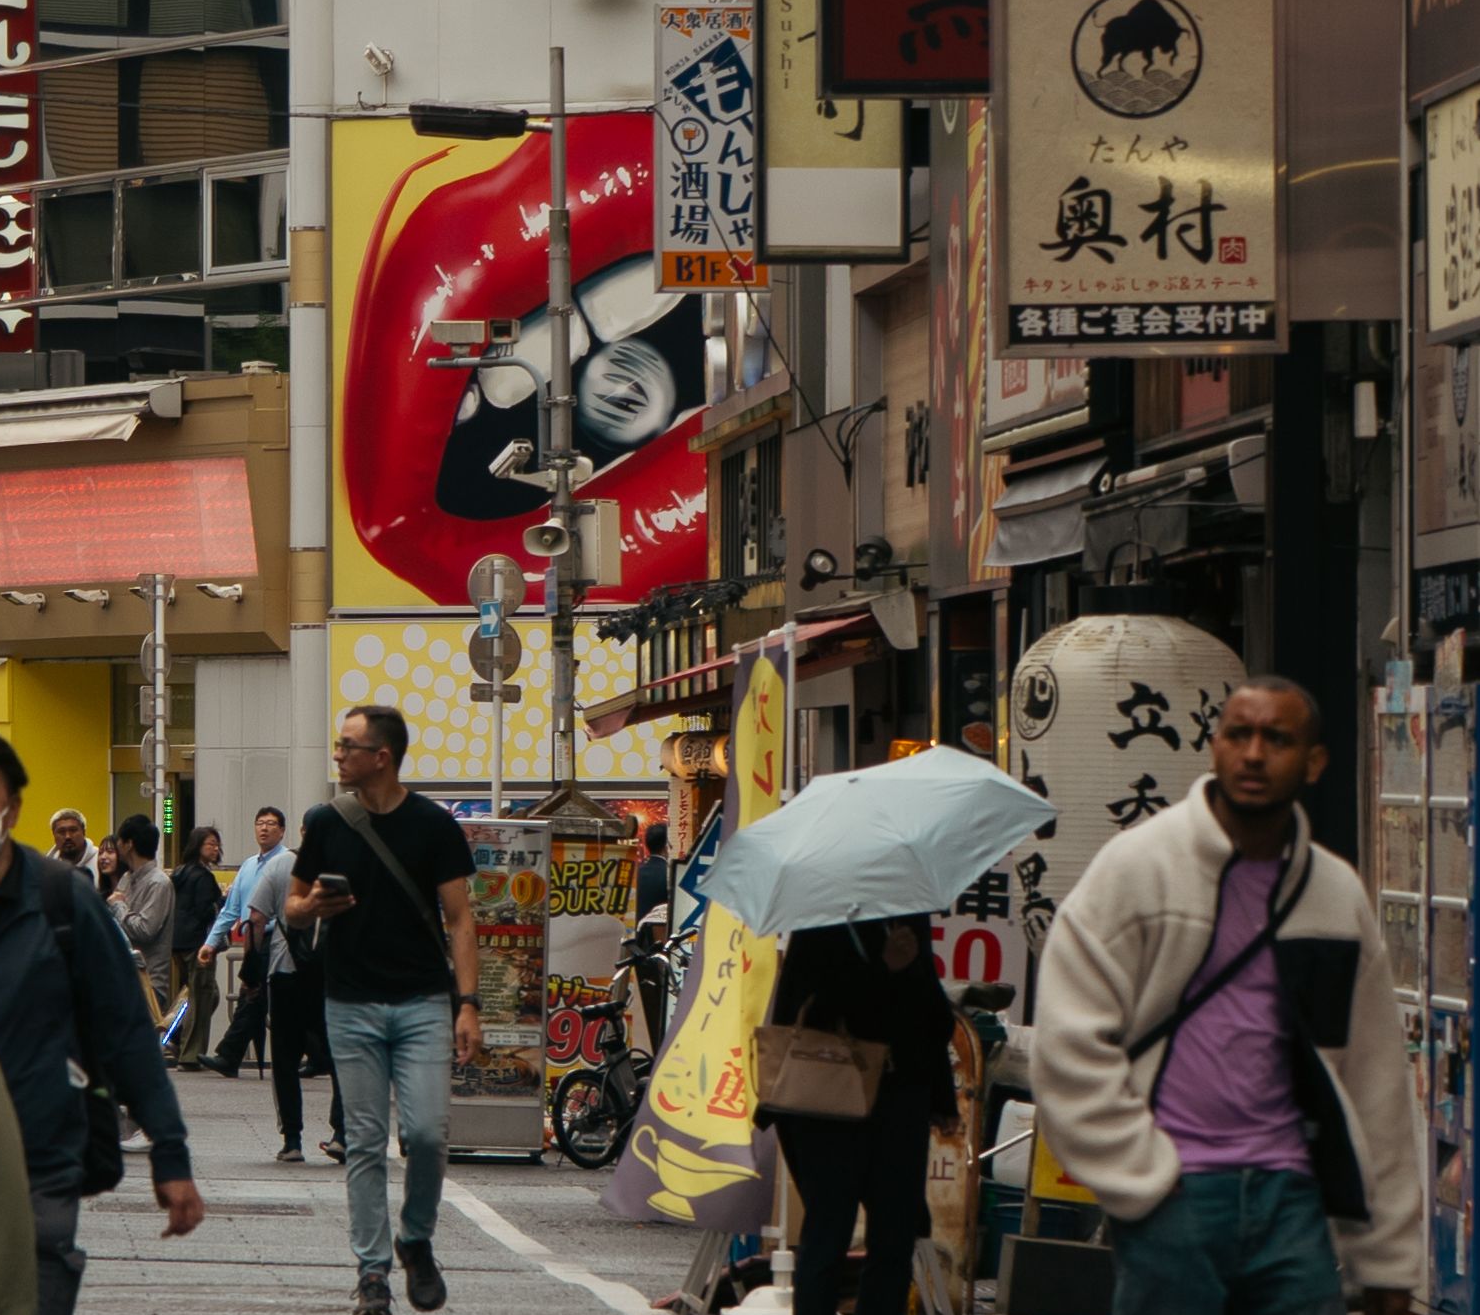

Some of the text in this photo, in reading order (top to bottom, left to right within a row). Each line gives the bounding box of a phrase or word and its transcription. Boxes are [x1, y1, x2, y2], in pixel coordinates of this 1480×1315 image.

[689, 60, 754, 247] もんじゃ
[1088, 134, 1190, 165] たんや
[669, 160, 710, 246] 酒場
[1038, 174, 1229, 265] 奥村
[675, 255, 722, 282] B1F
[1017, 306, 1267, 337] 各種ご宴会受付中
[548, 859, 615, 888] APPY
